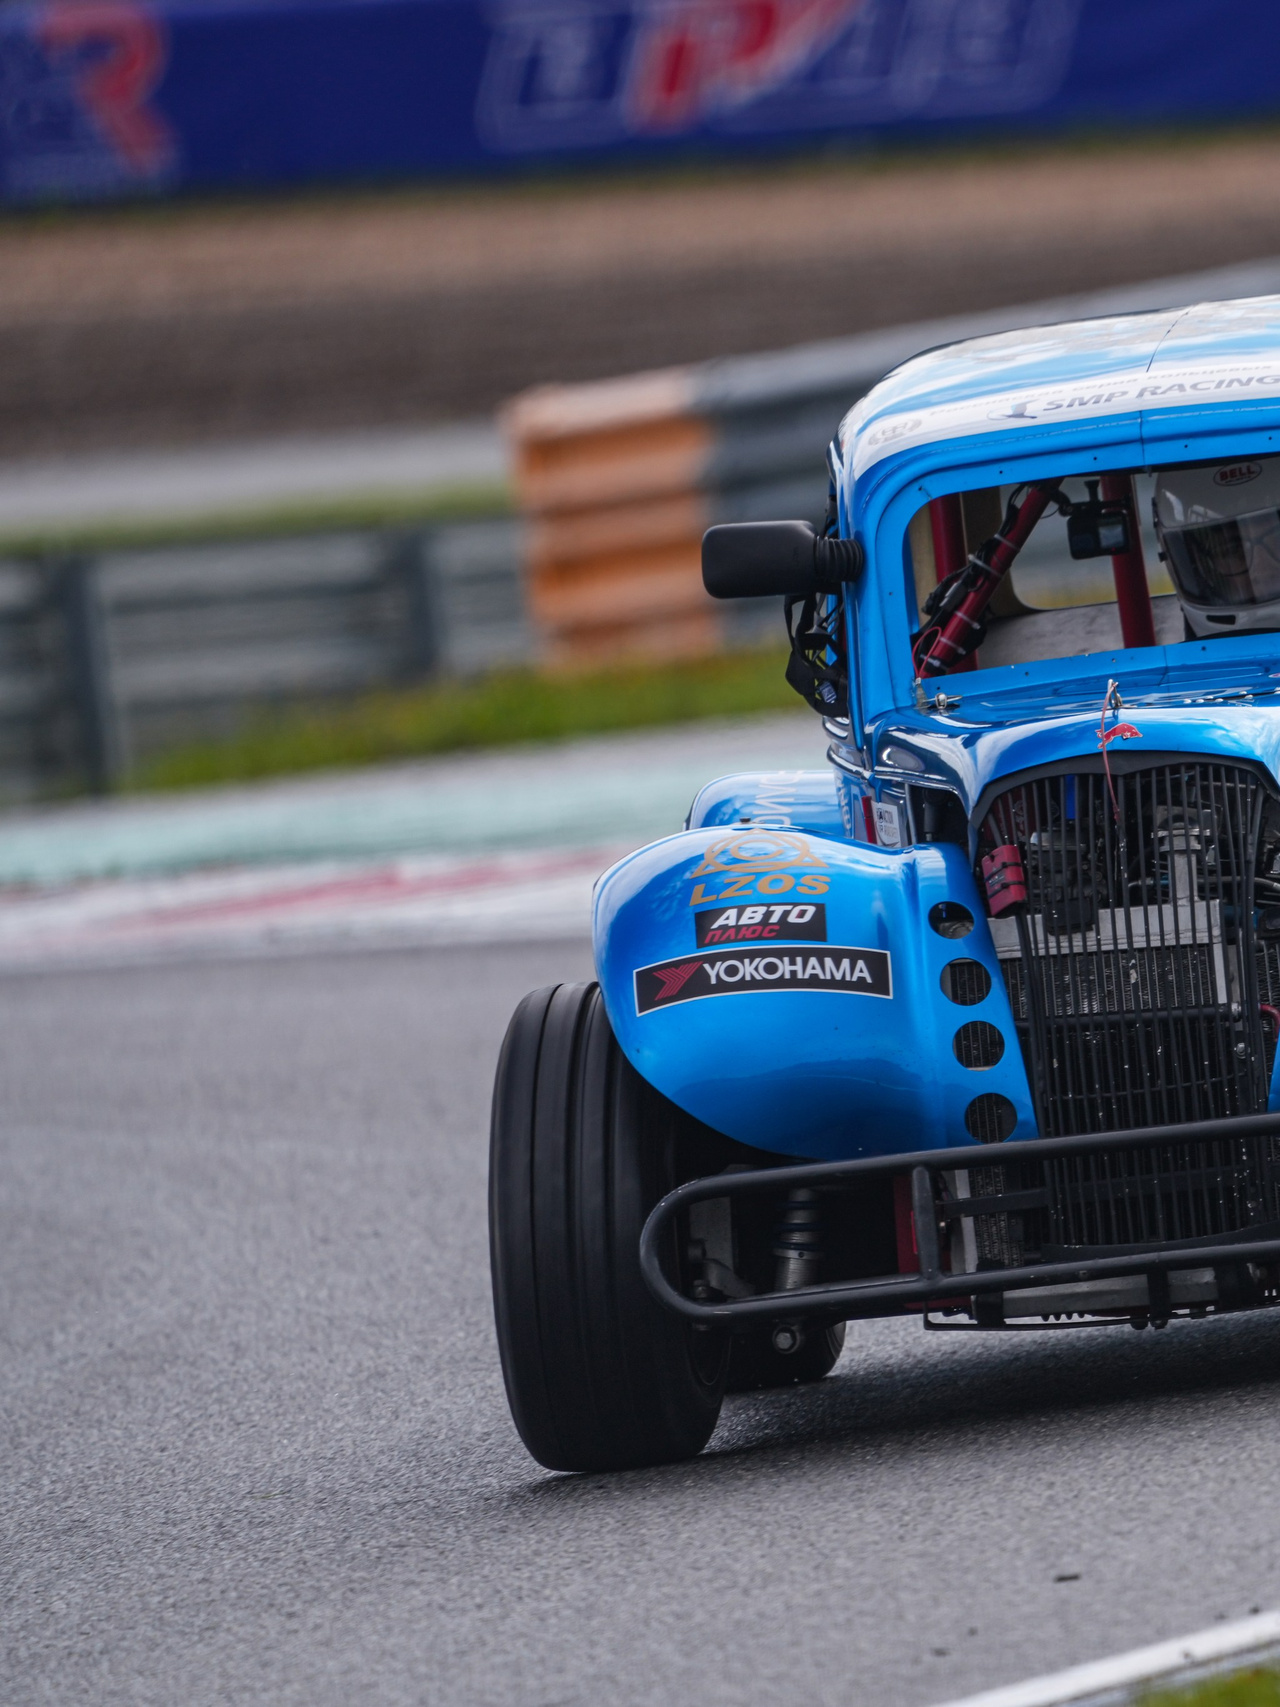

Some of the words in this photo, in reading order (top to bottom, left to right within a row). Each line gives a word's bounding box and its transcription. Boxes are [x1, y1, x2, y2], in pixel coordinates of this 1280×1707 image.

[1043, 390, 1130, 411] SMP
[1219, 465, 1256, 481] BELL
[689, 874, 831, 906] LZOS
[711, 905, 817, 929] АВТО
[704, 925, 780, 944] ПЛЮС
[702, 956, 873, 985] YOKOHAMA
